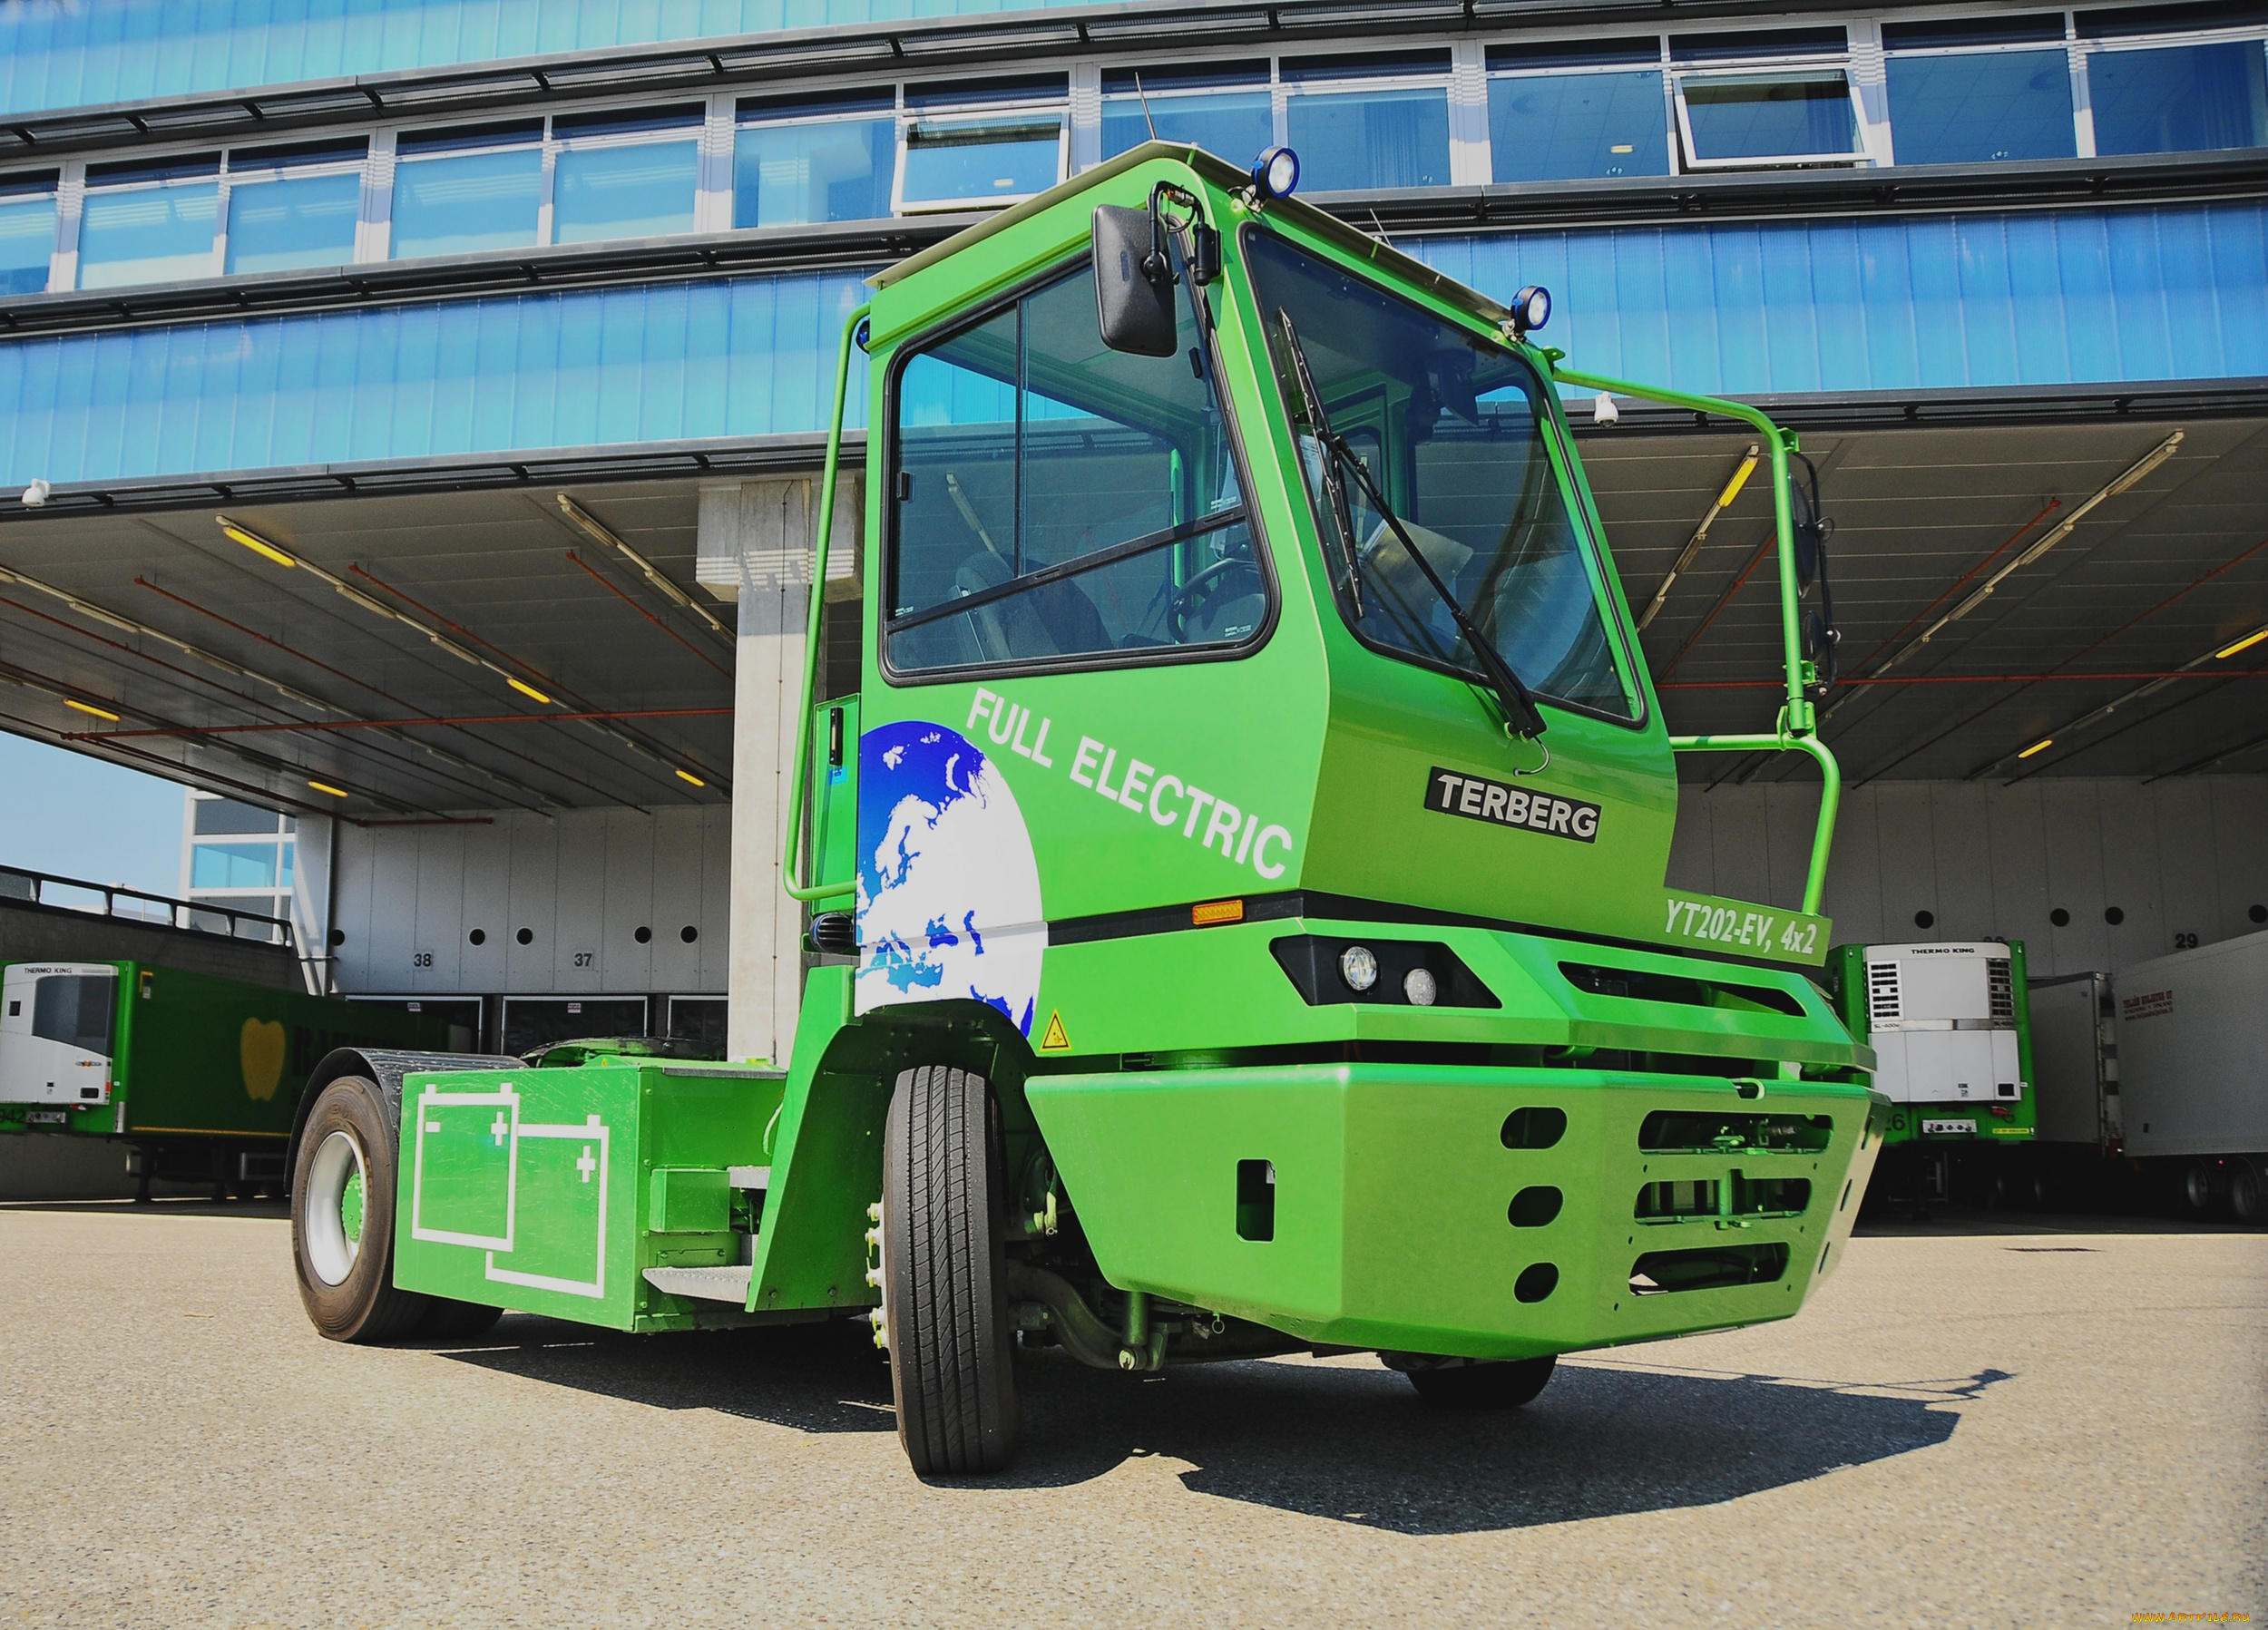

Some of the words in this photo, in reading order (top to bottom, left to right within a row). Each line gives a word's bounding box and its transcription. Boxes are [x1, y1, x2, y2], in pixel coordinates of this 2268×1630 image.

[966, 687, 1052, 768] FULL
[1069, 735, 1292, 879] ELECTRIC
[1437, 774, 1598, 837] TERBERG
[1665, 899, 1774, 953] YT202-EV,
[1781, 920, 1817, 954] 4x2
[2175, 932, 2198, 949] 29
[413, 953, 432, 967] 38
[574, 953, 592, 967] 37
